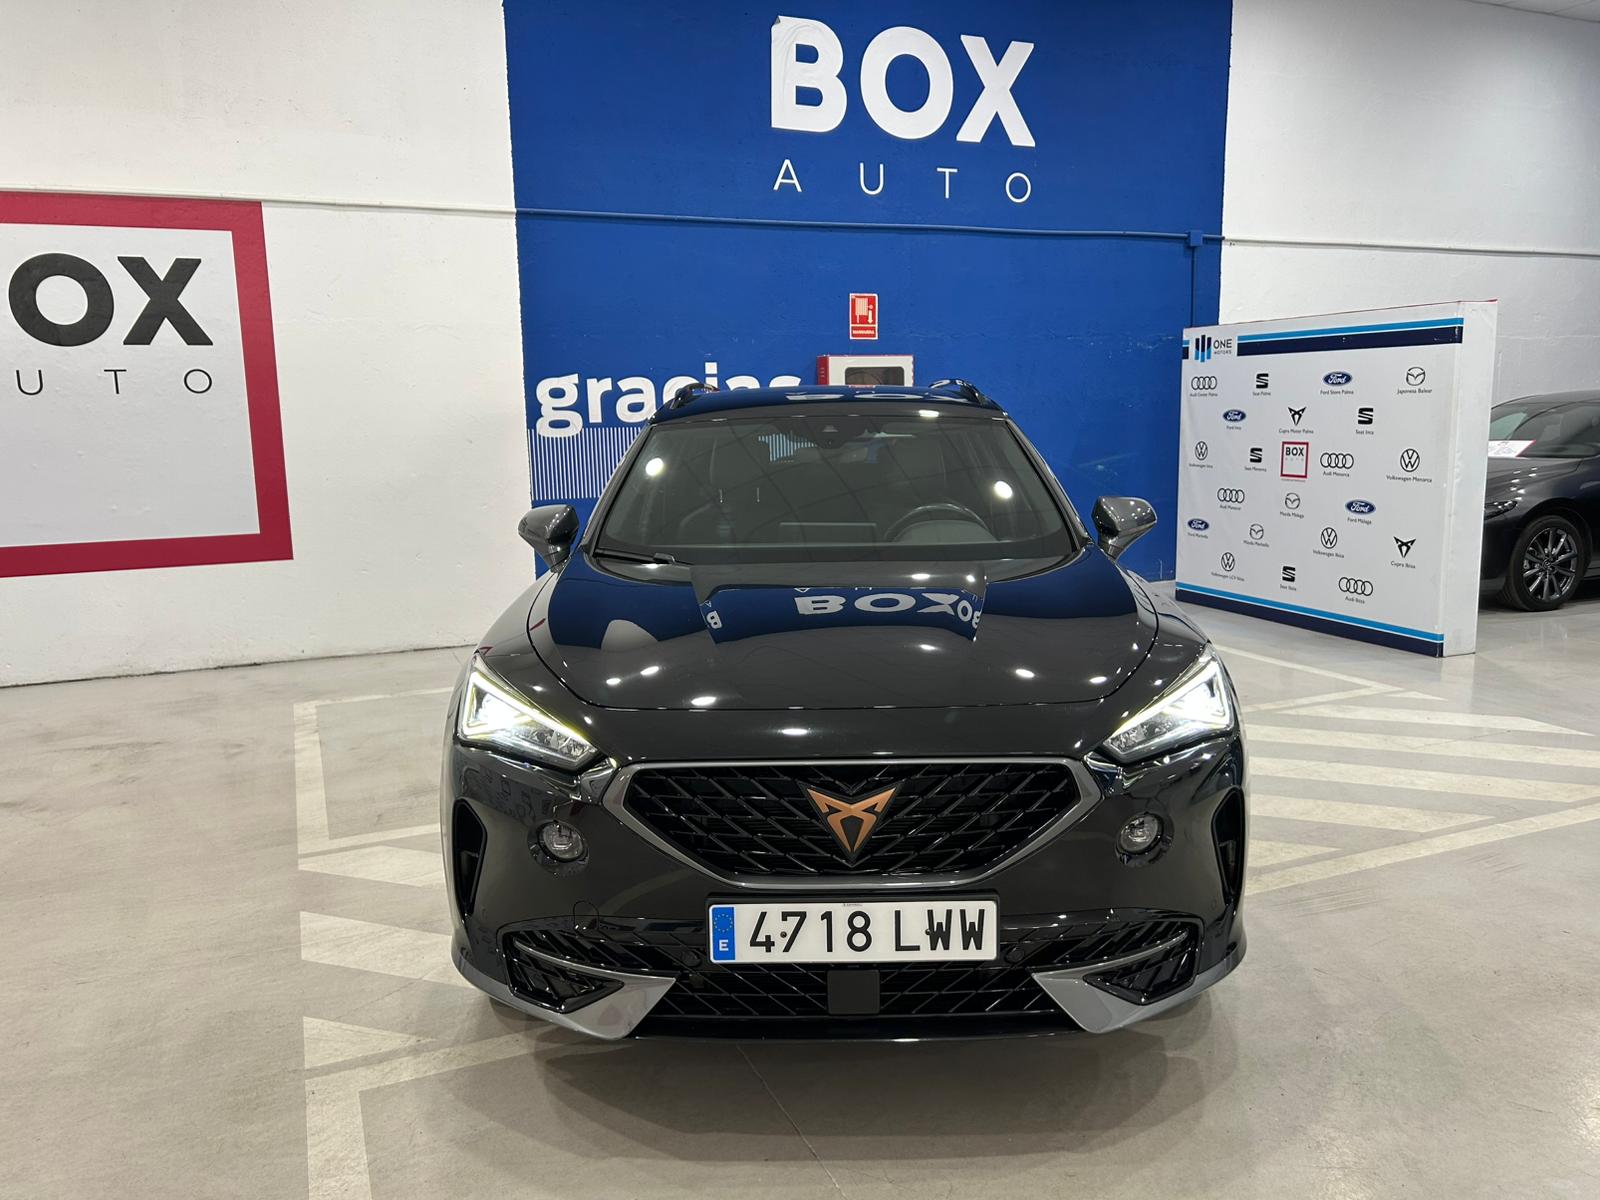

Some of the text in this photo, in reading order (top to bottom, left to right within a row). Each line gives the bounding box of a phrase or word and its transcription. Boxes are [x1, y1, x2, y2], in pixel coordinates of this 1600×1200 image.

[771, 15, 1036, 147] BOX
[773, 159, 1032, 203] AUTO
[8, 252, 214, 347] OX
[1213, 339, 1233, 349] ONE
[15, 368, 213, 396] UTO
[536, 362, 802, 438] grac
[1285, 447, 1304, 457] BOX
[718, 939, 729, 951] E
[749, 908, 985, 953] 4718 LWW
